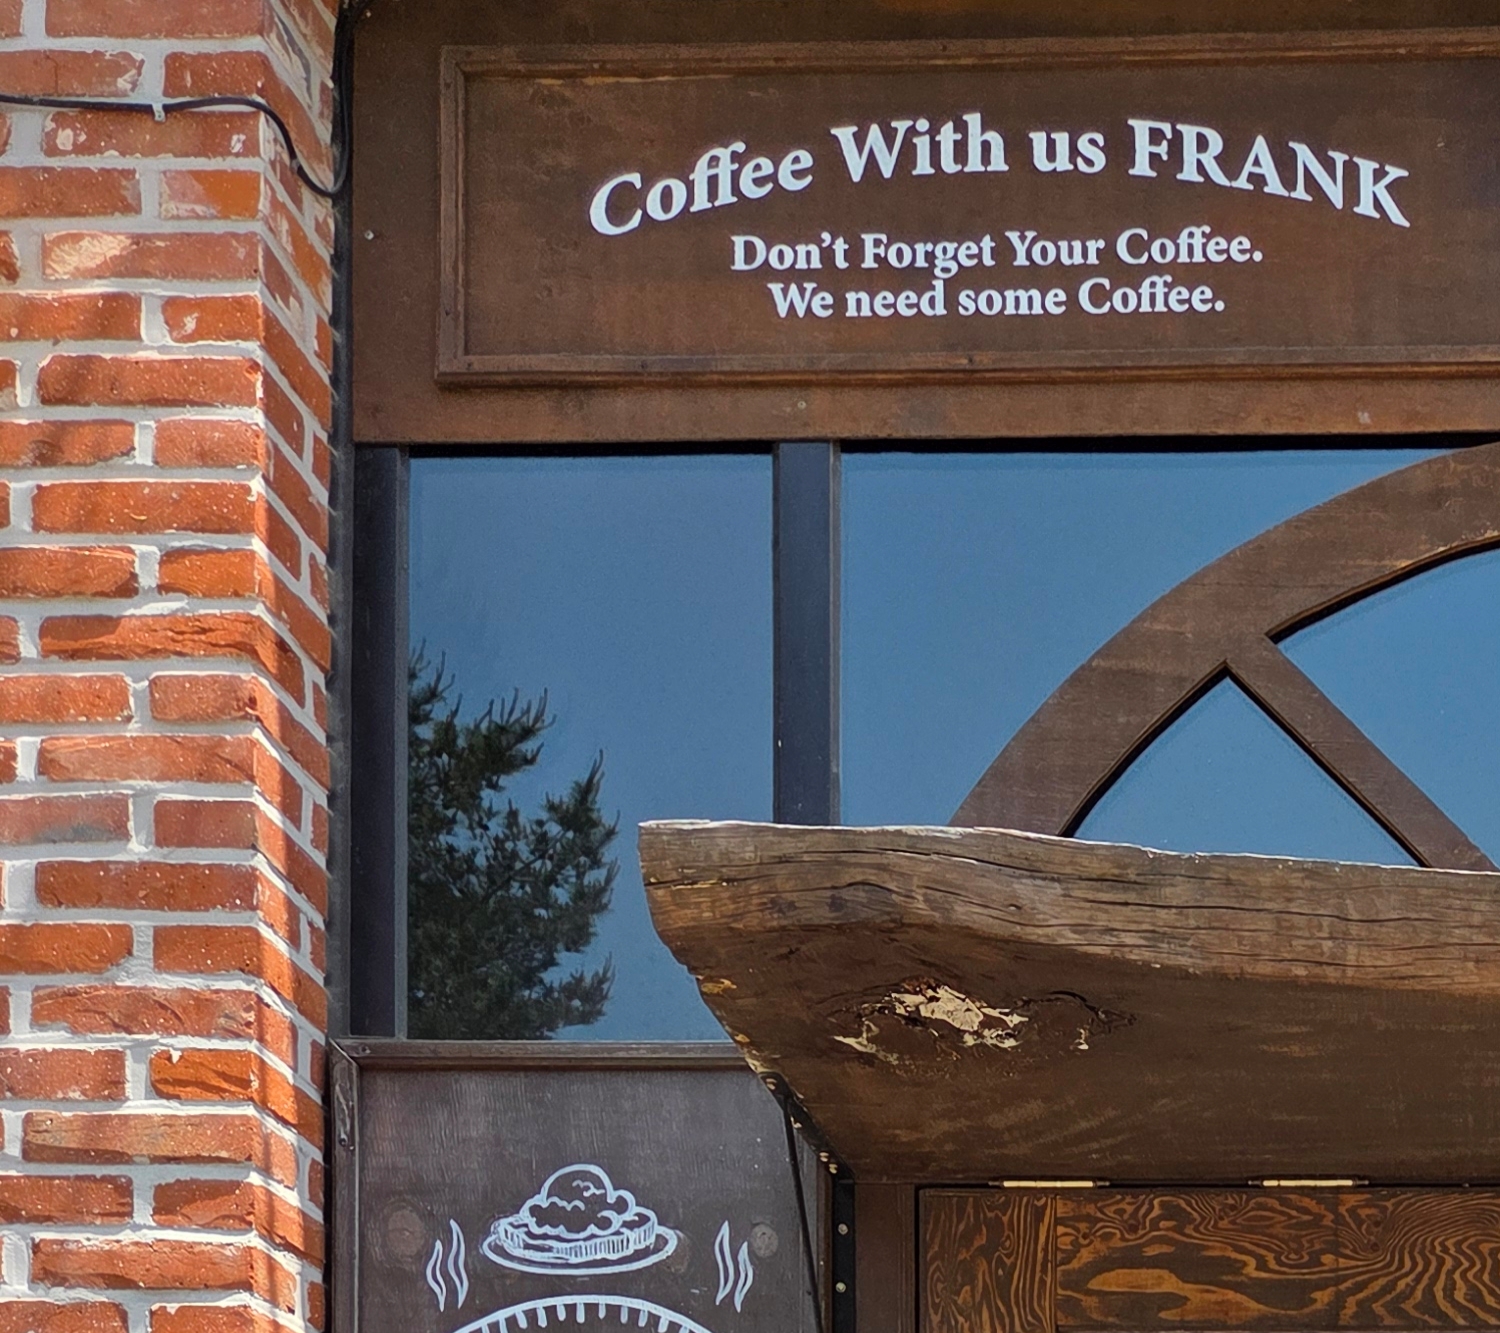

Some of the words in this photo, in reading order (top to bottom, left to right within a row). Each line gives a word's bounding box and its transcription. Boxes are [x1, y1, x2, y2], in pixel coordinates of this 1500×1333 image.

[589, 142, 813, 236] Coffee
[831, 112, 1008, 183] With
[1029, 131, 1107, 175] us
[1125, 118, 1411, 228] FRANK
[731, 233, 849, 272] Don't
[861, 232, 996, 282] Forget
[1005, 231, 1106, 267] Your
[1117, 225, 1263, 265] Coffee.
[767, 282, 834, 320] We
[846, 279, 947, 318] need
[959, 287, 1067, 317] some
[1078, 275, 1226, 316] Coffee.
